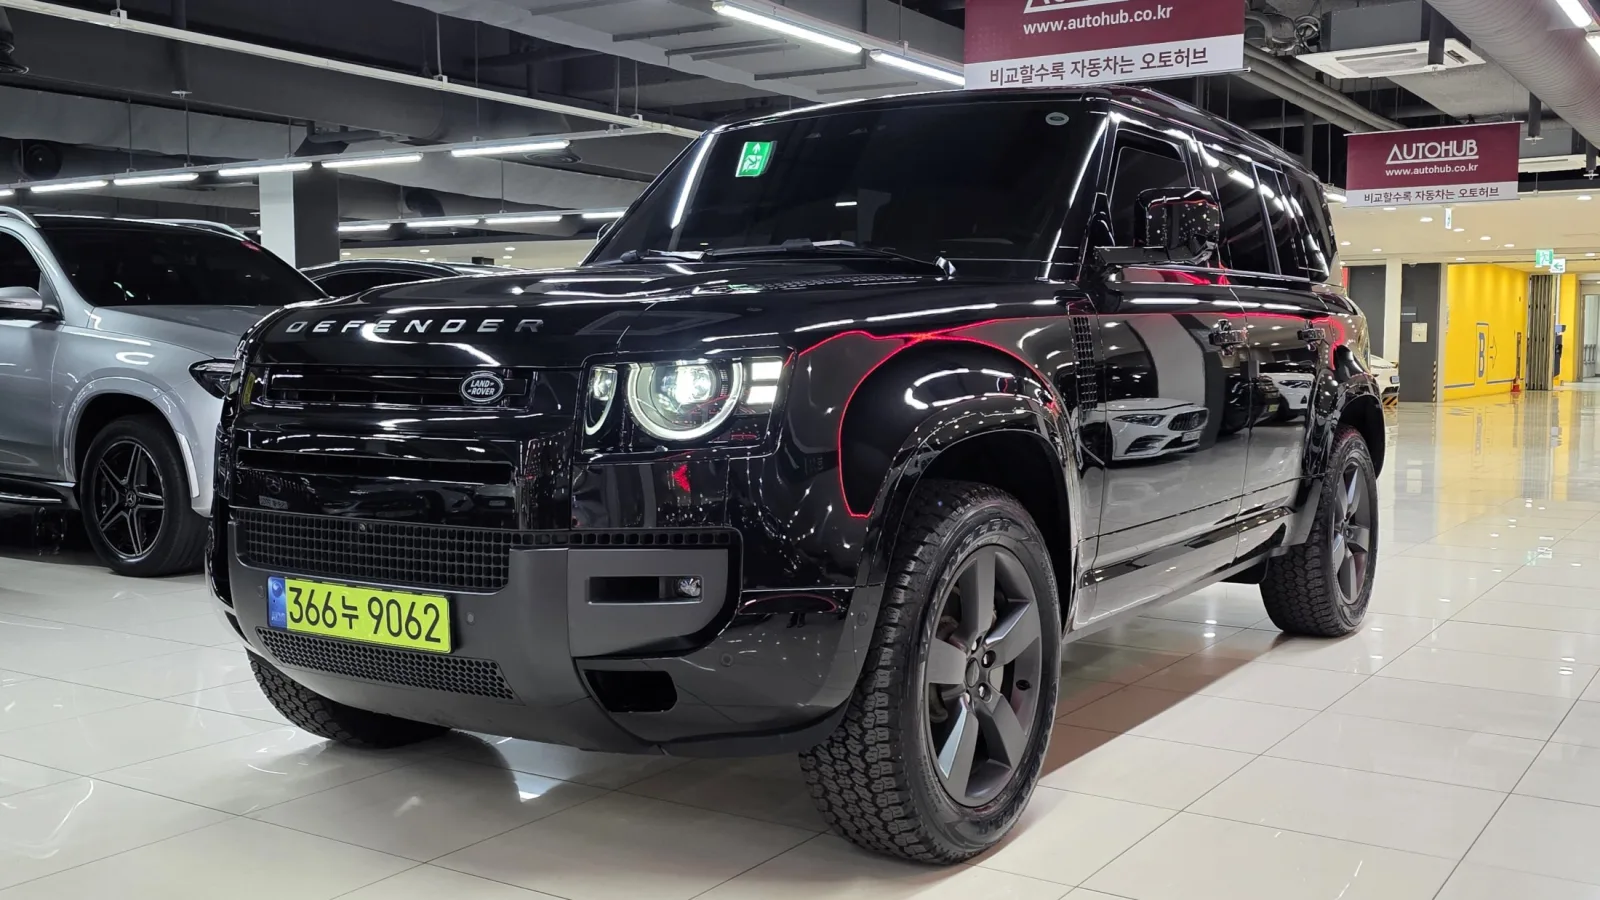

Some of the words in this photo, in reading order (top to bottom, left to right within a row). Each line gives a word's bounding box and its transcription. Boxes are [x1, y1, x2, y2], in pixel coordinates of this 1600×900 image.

[1023, 5, 1173, 35] www.autohub.co.kr
[990, 61, 1066, 86] 비교할수록
[1070, 55, 1135, 79] 자동차는
[1140, 47, 1208, 70] 오토허브
[1386, 139, 1479, 165] AUTOHUB
[1385, 163, 1479, 177] www.autohub.co.kr
[1364, 190, 1412, 204] 비교할수록
[1415, 188, 1455, 201] 자동차는
[1458, 186, 1500, 199] 오토허브
[286, 319, 544, 334] DEFENDER
[289, 586, 359, 630] 366누
[367, 596, 441, 643] 9062
